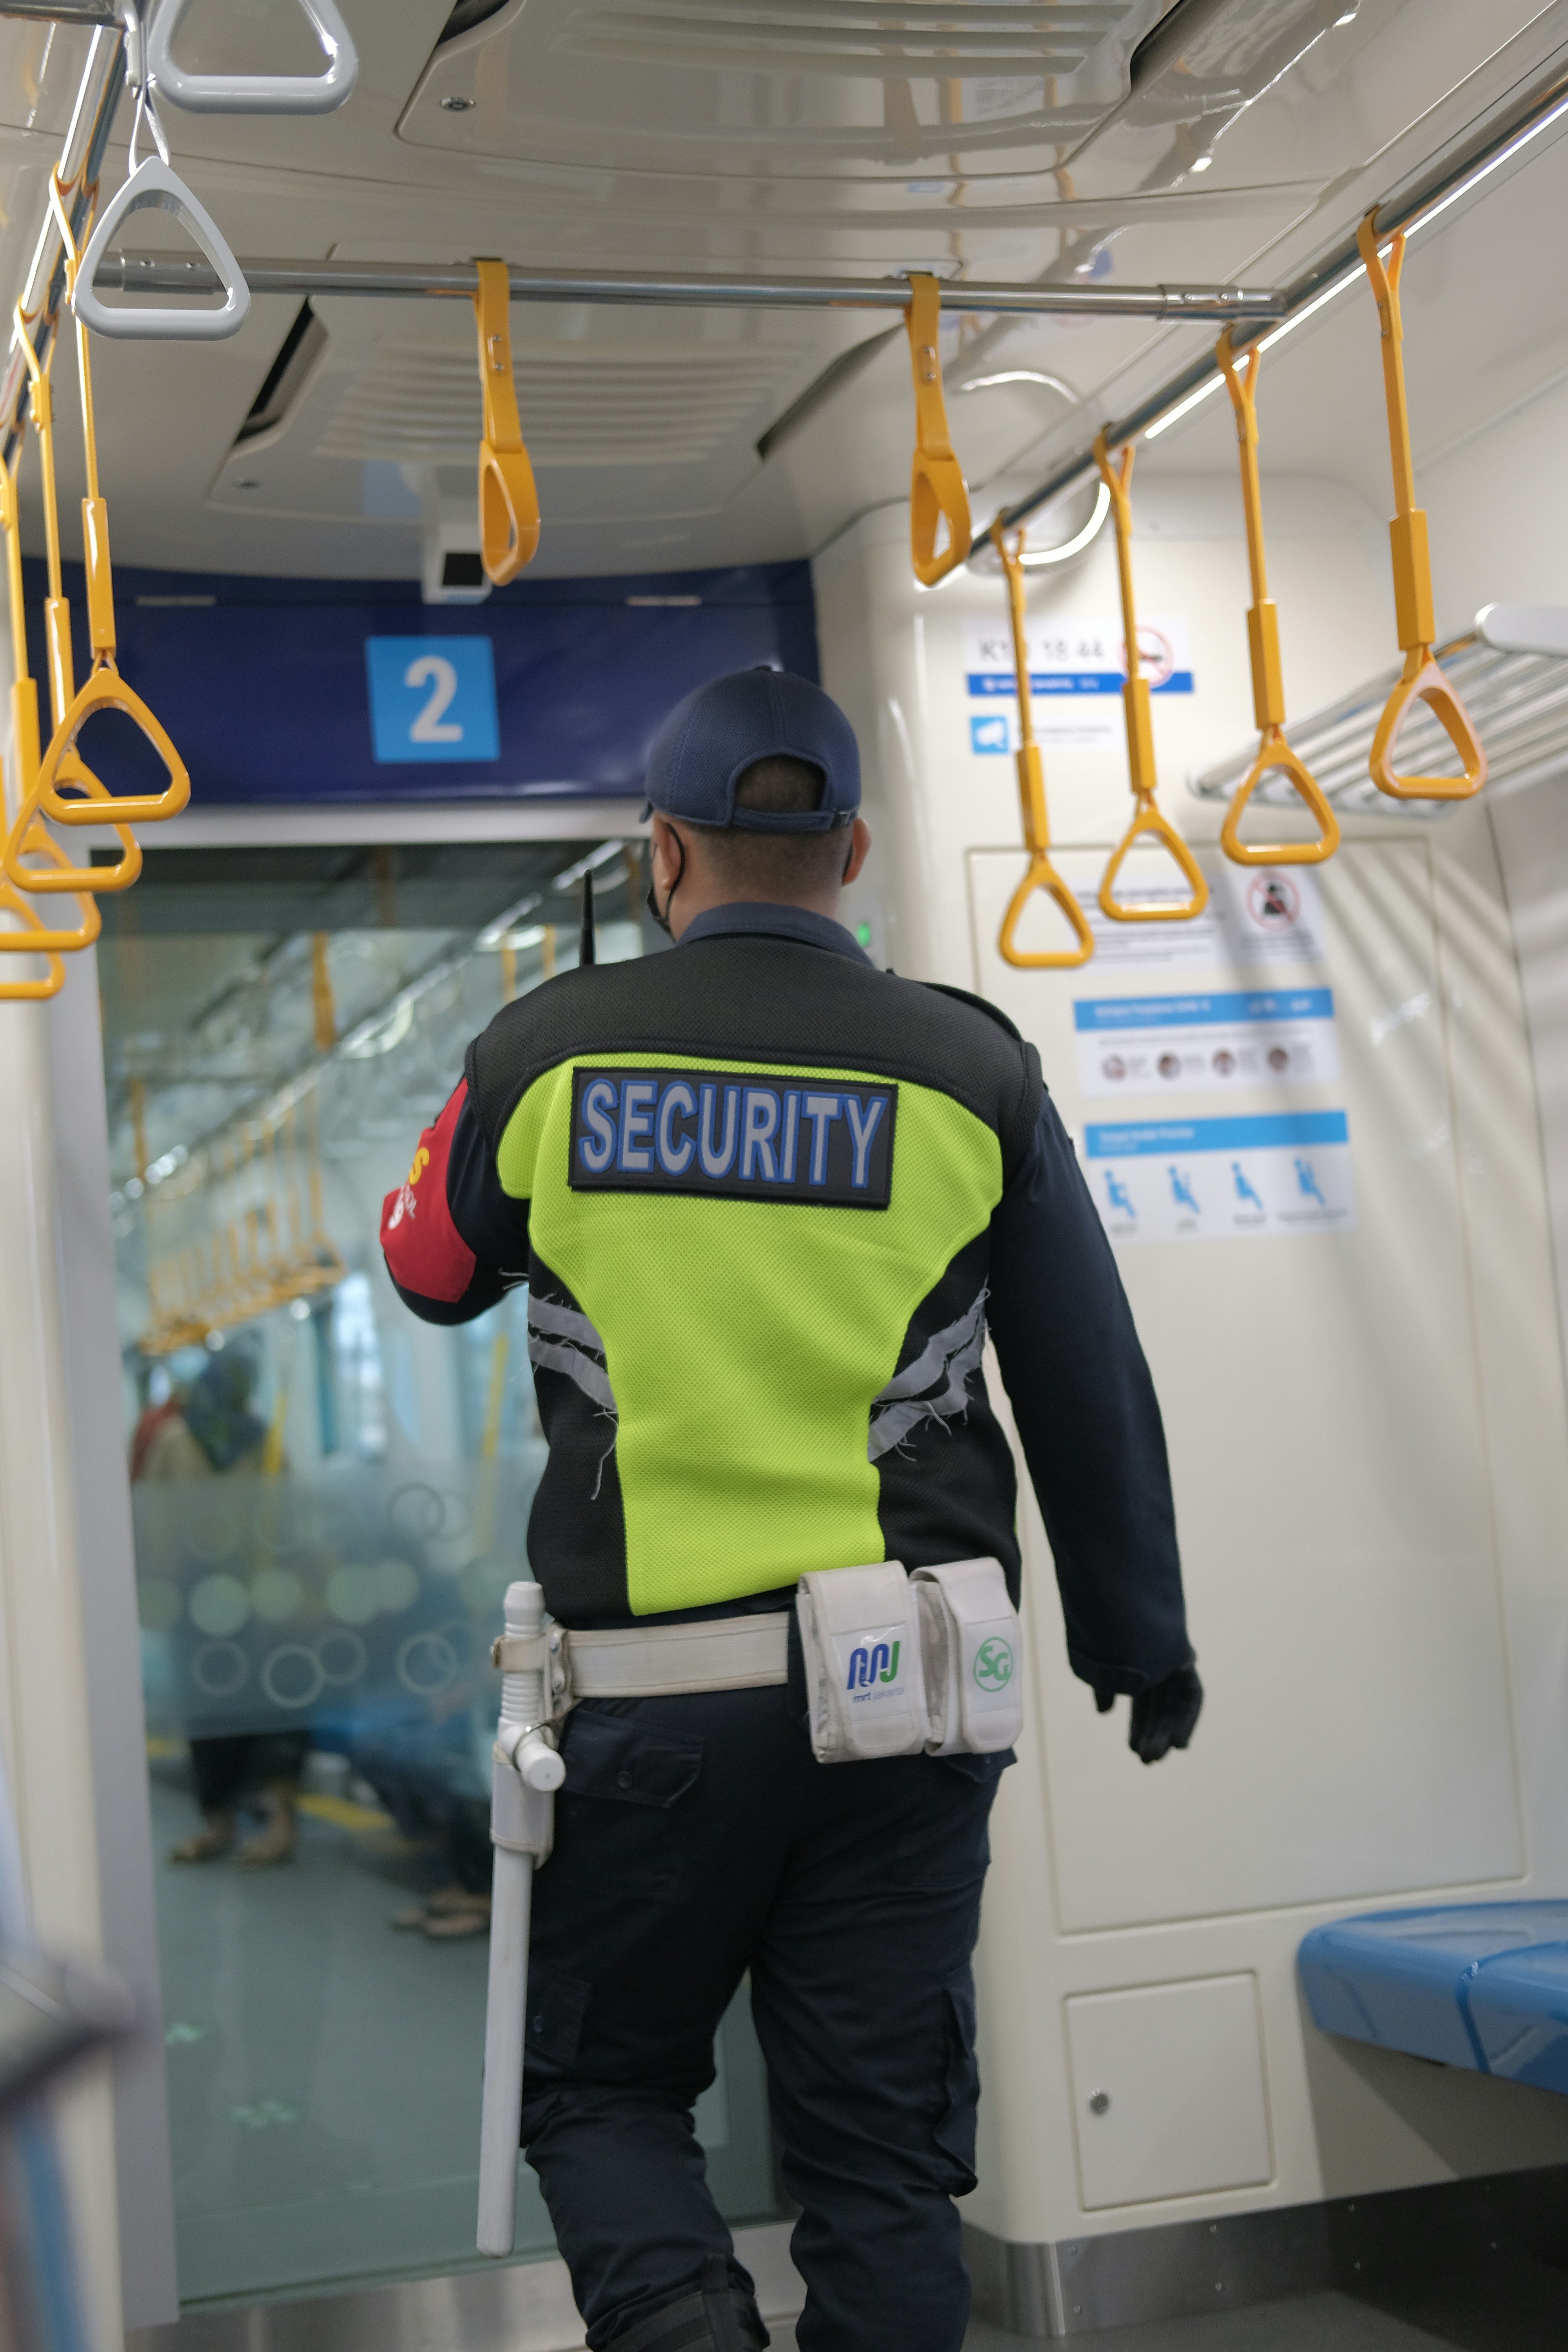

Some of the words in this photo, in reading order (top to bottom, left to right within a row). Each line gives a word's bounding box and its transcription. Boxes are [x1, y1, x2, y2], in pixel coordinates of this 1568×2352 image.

[404, 655, 463, 742] 2
[579, 1078, 887, 1189] SECURITY
[978, 1645, 1010, 1681] SG
[853, 1692, 871, 1703] mrt
